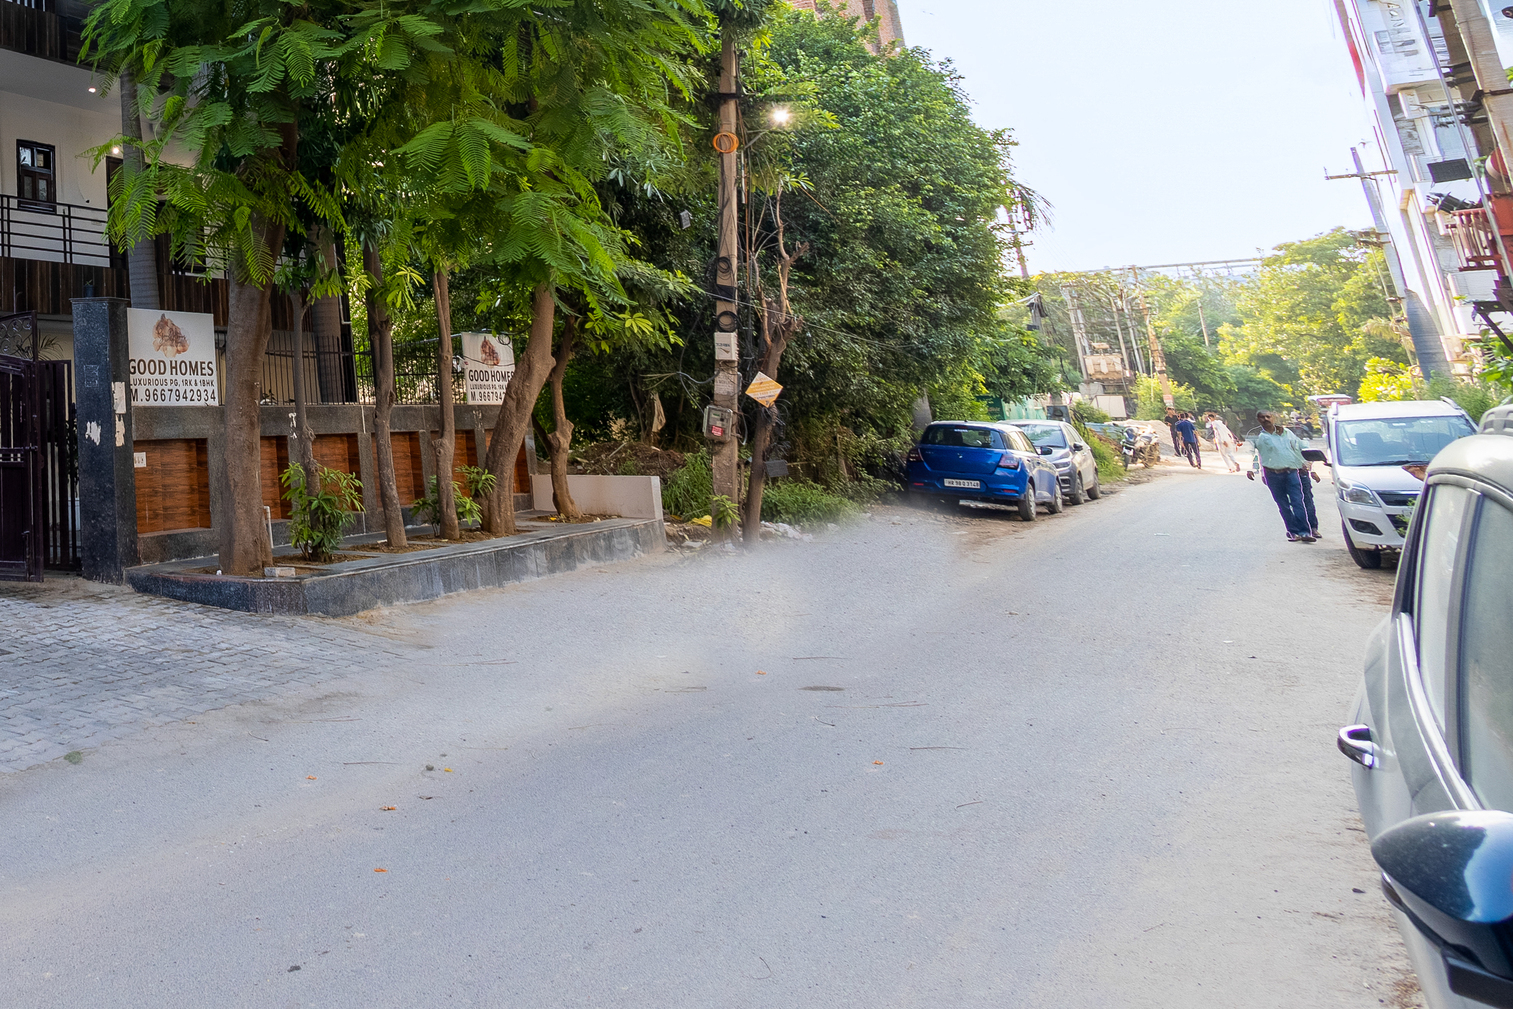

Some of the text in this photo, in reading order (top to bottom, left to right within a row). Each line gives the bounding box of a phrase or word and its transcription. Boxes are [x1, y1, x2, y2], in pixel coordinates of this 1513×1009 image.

[129, 359, 214, 377] GOOD HOMES
[468, 369, 490, 382] GOOD
[130, 378, 215, 387] UXURIOUS PG, 1RK & 1BHK
